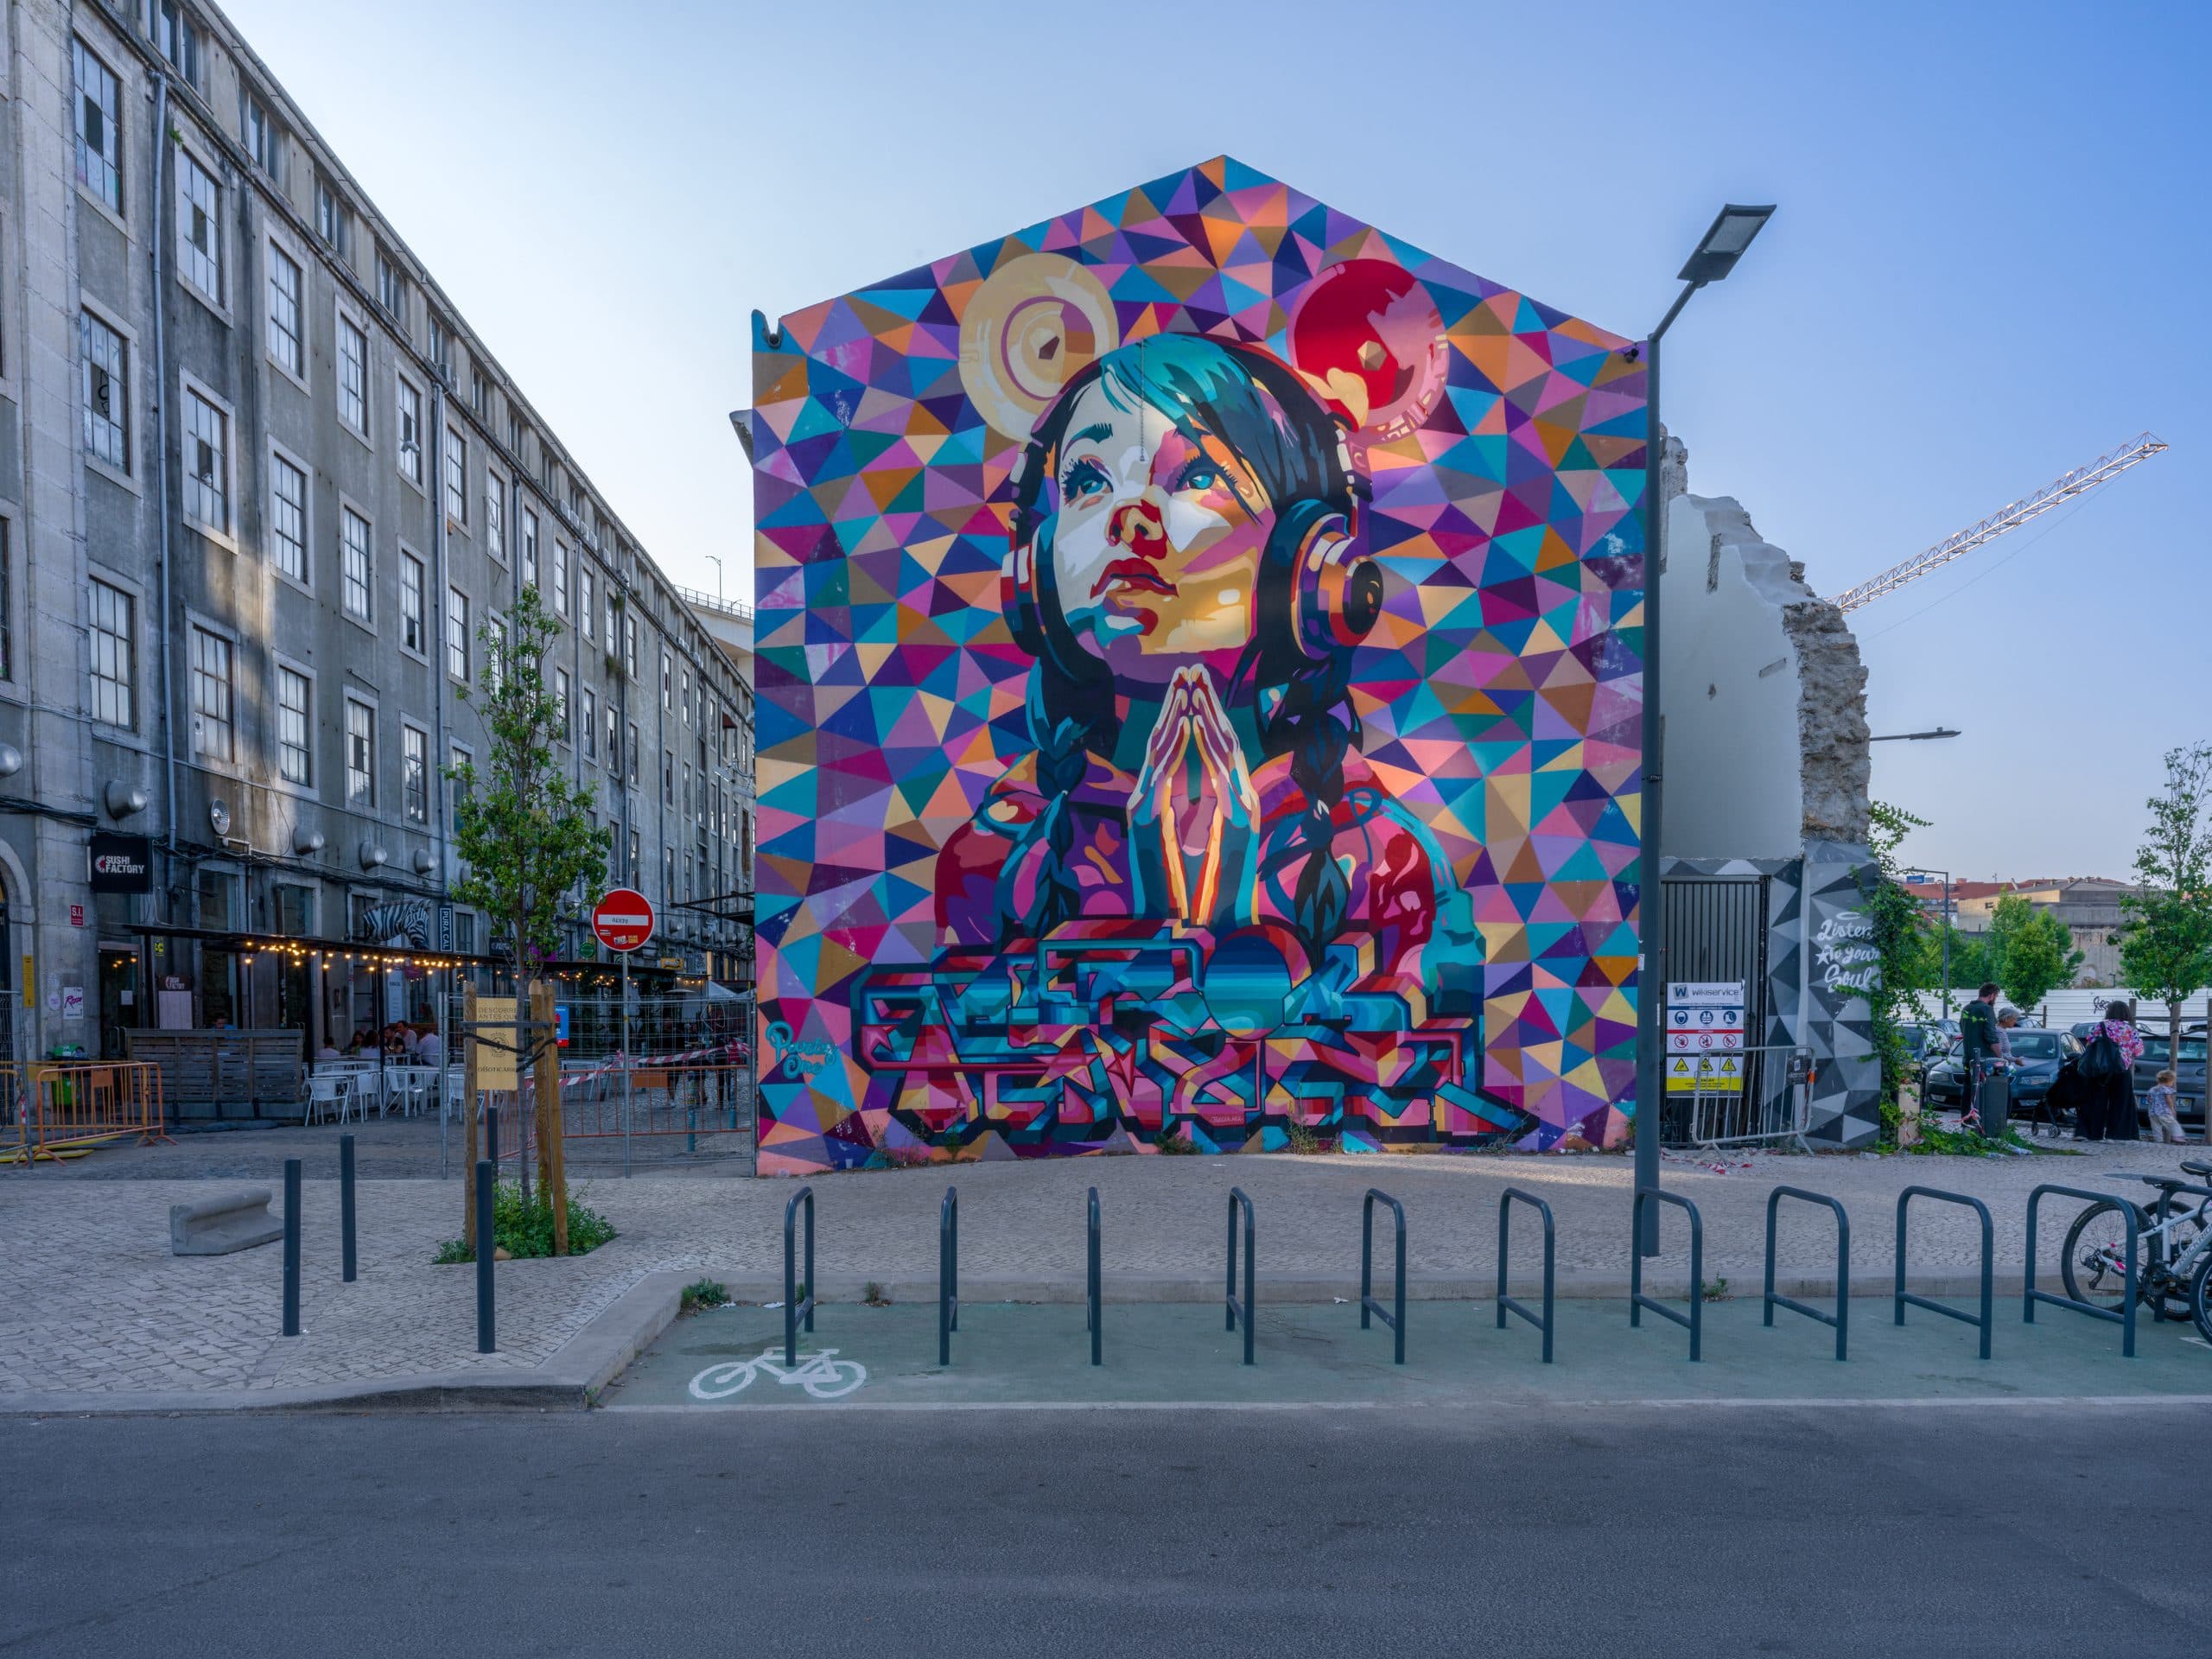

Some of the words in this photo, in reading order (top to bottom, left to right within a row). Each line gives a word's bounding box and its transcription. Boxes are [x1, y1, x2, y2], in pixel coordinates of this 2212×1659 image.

[105, 855, 130, 864] SUSHI
[105, 865, 144, 874] FACTORY
[1841, 946, 1881, 964] your
[1824, 963, 1872, 994] Soul
[1692, 988, 1739, 996] wikiservice
[783, 1055, 823, 1079] One
